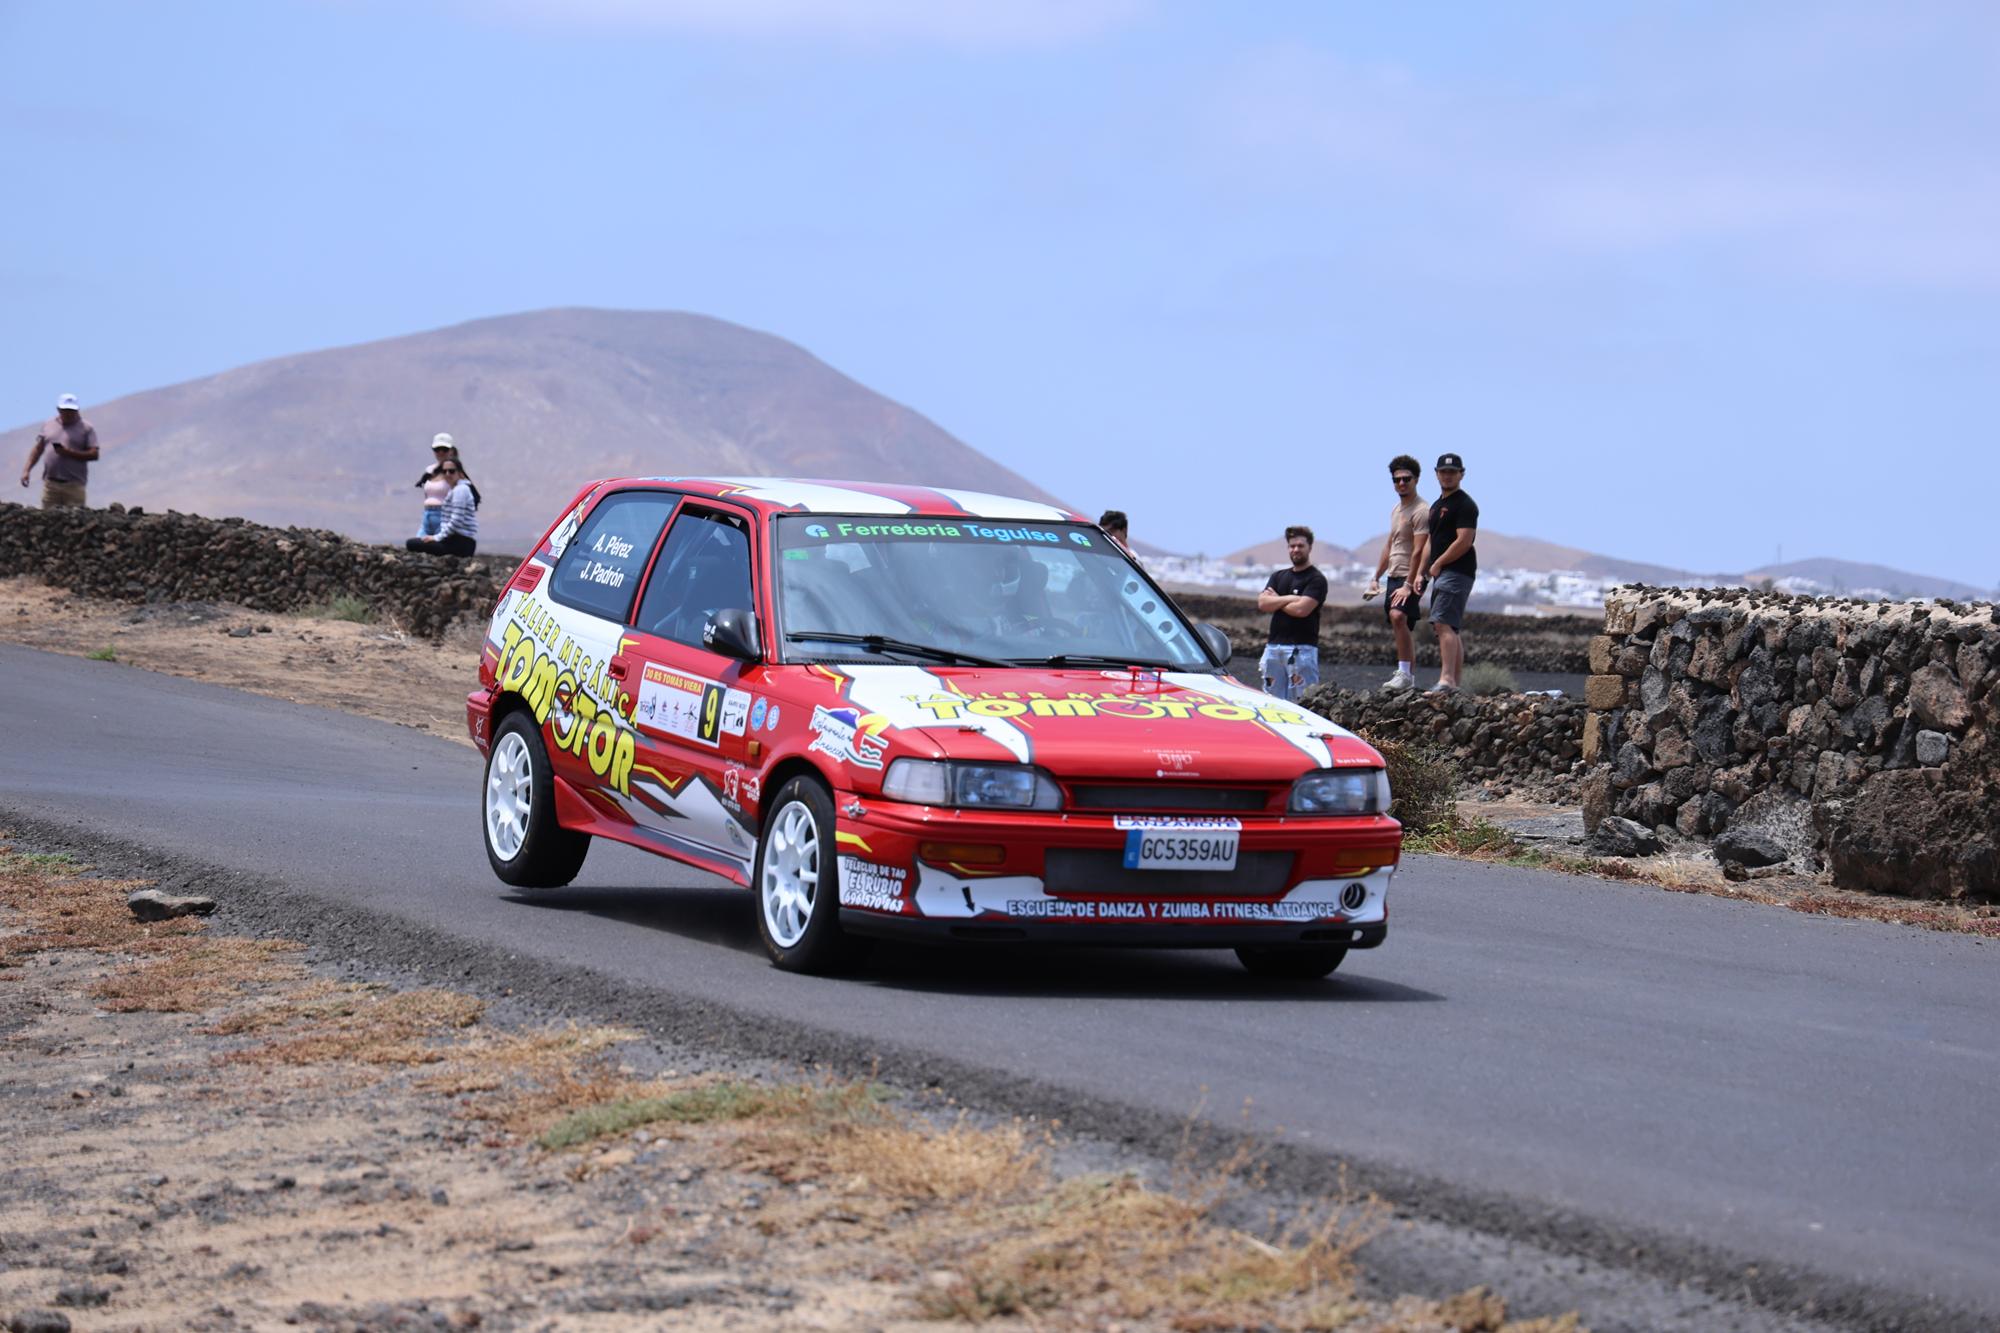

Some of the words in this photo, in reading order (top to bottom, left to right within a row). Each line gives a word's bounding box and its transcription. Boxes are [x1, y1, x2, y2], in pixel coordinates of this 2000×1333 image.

[837, 523, 961, 537] Ferreteria
[963, 524, 1060, 542] Teguise
[592, 533, 603, 552] A.
[604, 536, 634, 558] Pérez
[580, 560, 592, 580] J.
[590, 562, 624, 588] Padrón
[514, 592, 560, 652] TALLER
[557, 635, 638, 730] MECÁNICA
[703, 688, 718, 738] 9
[1141, 838, 1235, 861] GC5359AU
[879, 865, 890, 877] DE
[849, 872, 863, 890] EL
[864, 875, 903, 897] RUBIO
[1076, 902, 1096, 917] DE
[1098, 902, 1146, 918] DANZA
[1148, 902, 1158, 918] Y
[1161, 902, 1210, 918] ZUMBA
